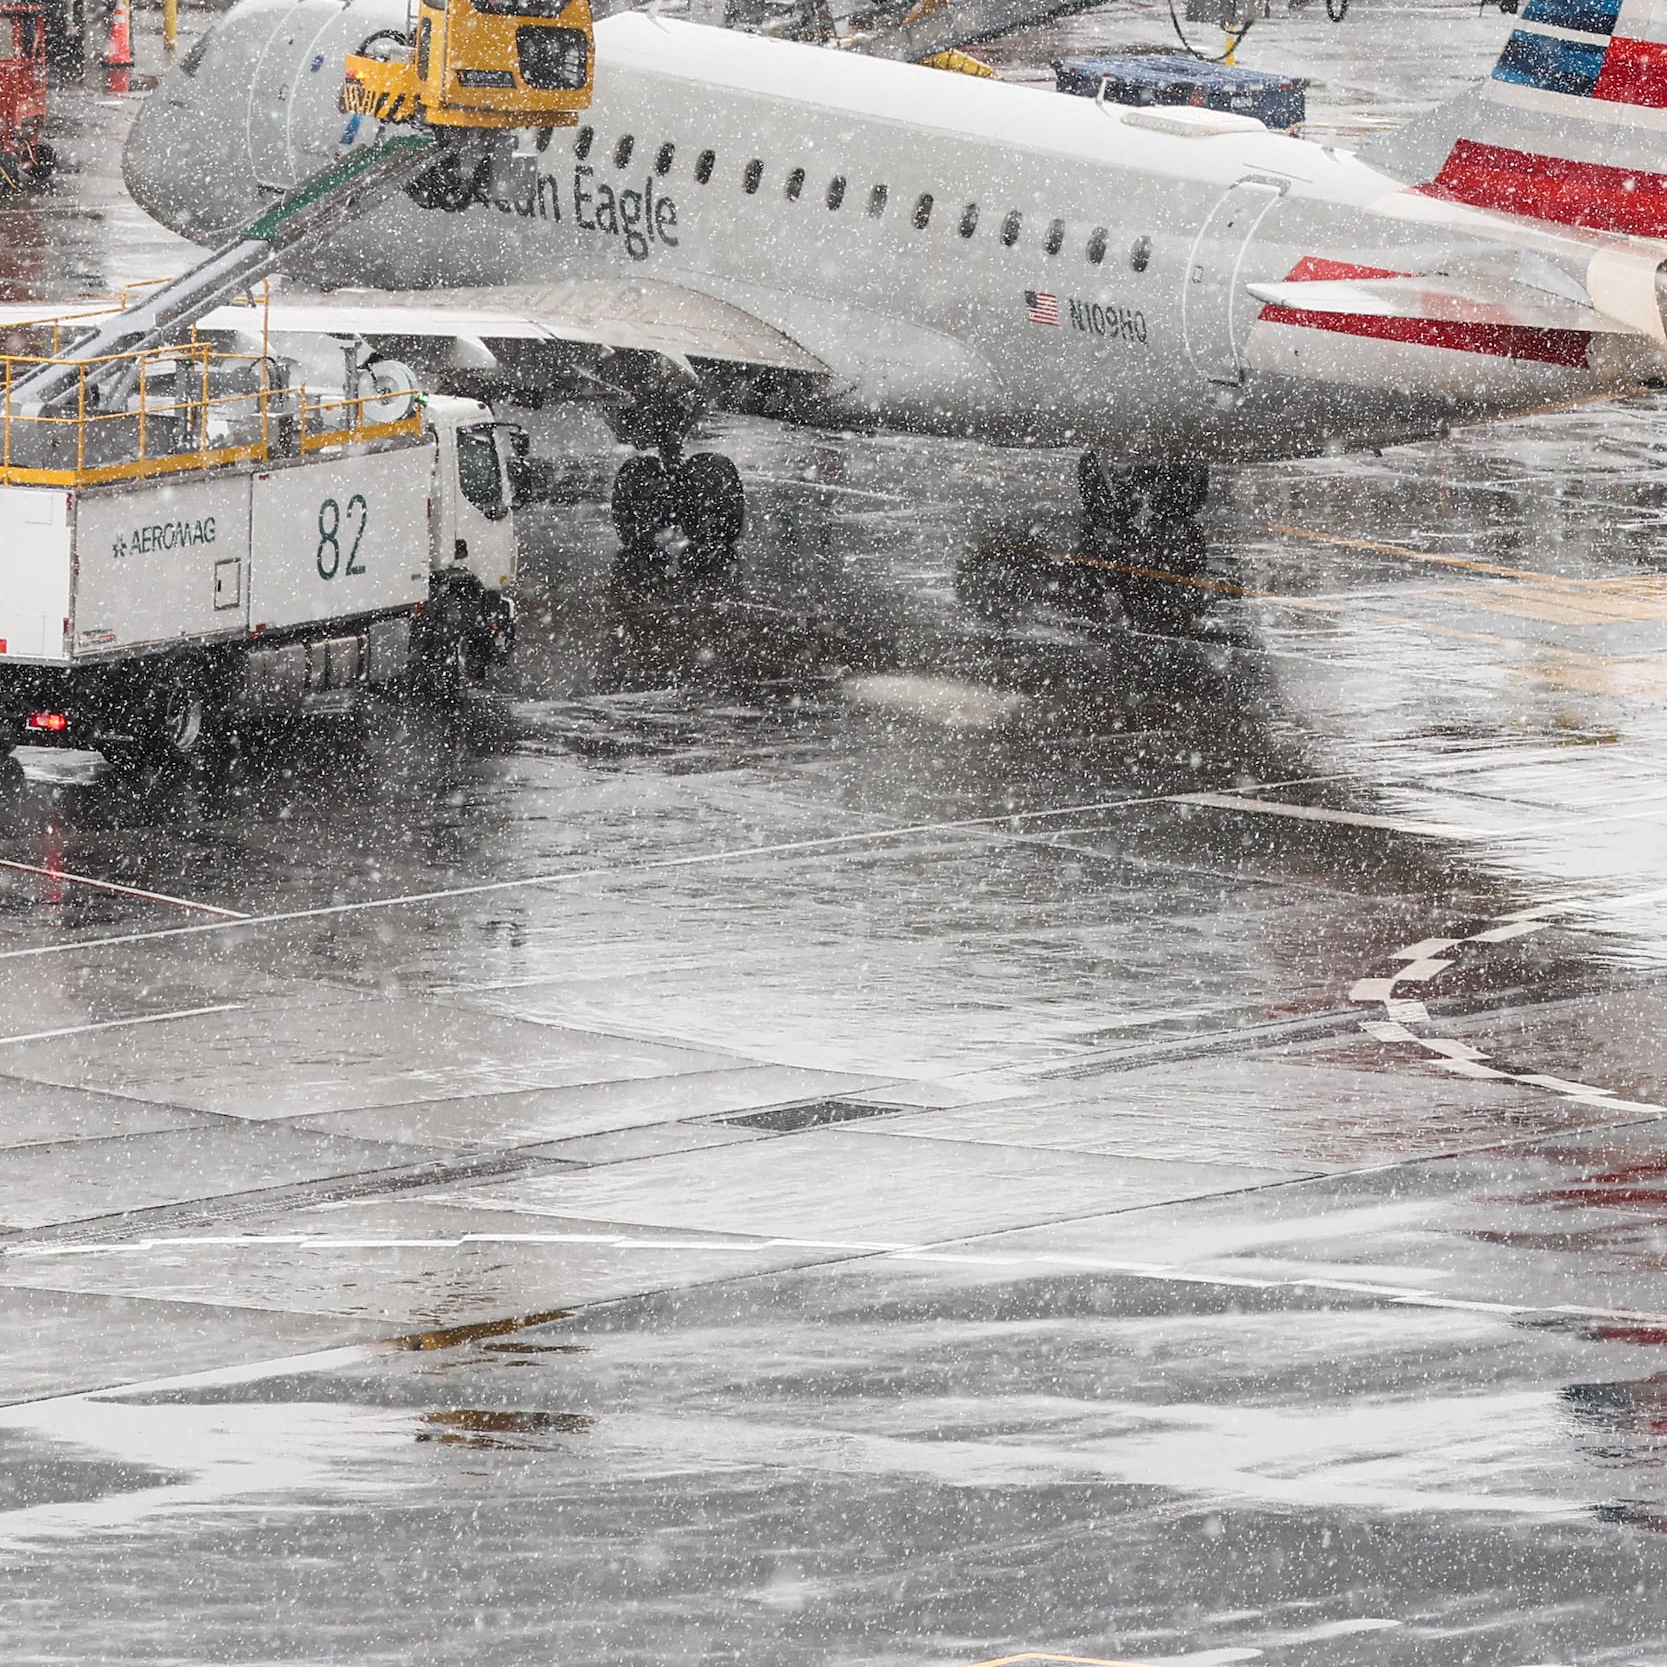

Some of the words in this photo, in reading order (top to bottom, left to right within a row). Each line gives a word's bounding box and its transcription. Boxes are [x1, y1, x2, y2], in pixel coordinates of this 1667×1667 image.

[573, 164, 677, 261] Eagle
[1068, 297, 1150, 348] N109HQ
[128, 516, 216, 556] AEROMAG
[316, 493, 368, 582] 82
